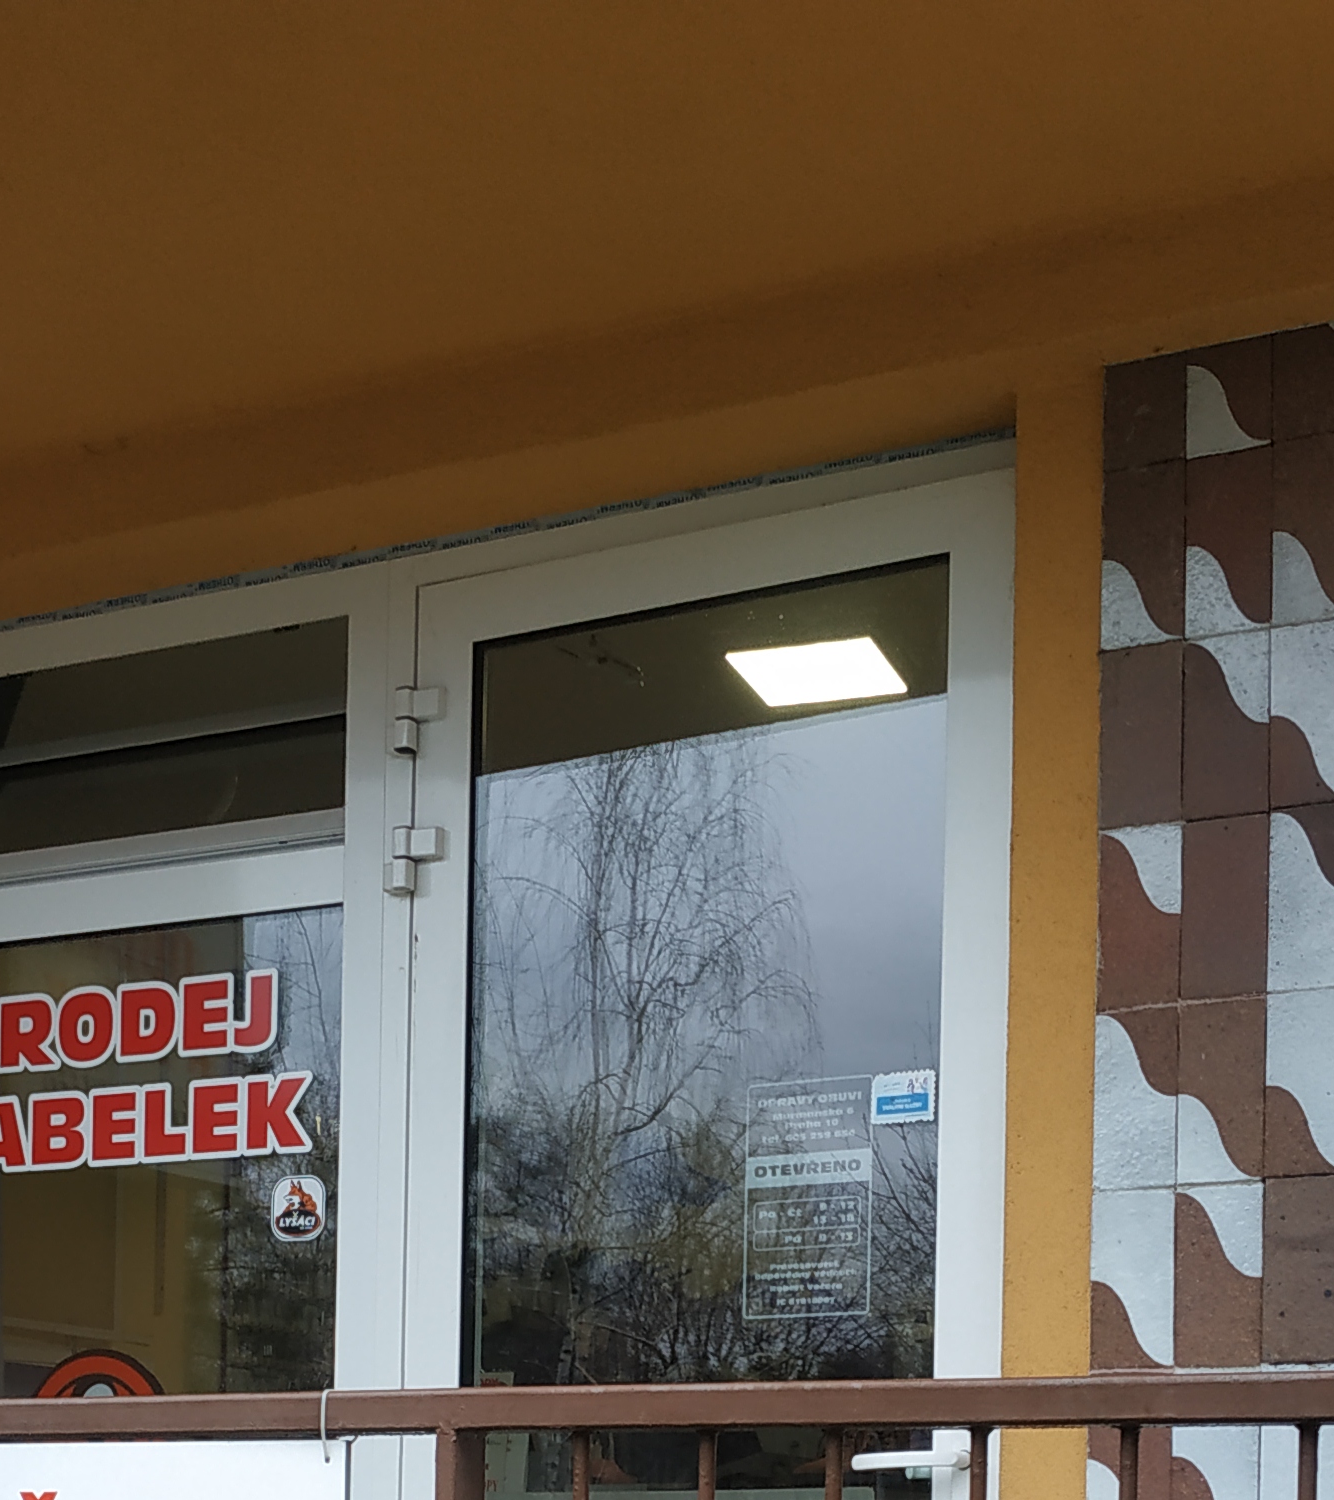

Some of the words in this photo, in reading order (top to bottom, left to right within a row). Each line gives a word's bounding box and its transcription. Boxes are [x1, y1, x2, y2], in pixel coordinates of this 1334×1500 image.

[758, 1095, 816, 1108] OPRAVY
[818, 1091, 862, 1104] OBUVI
[826, 1118, 839, 1127] 10
[754, 1158, 862, 1178] OTEVŘENO
